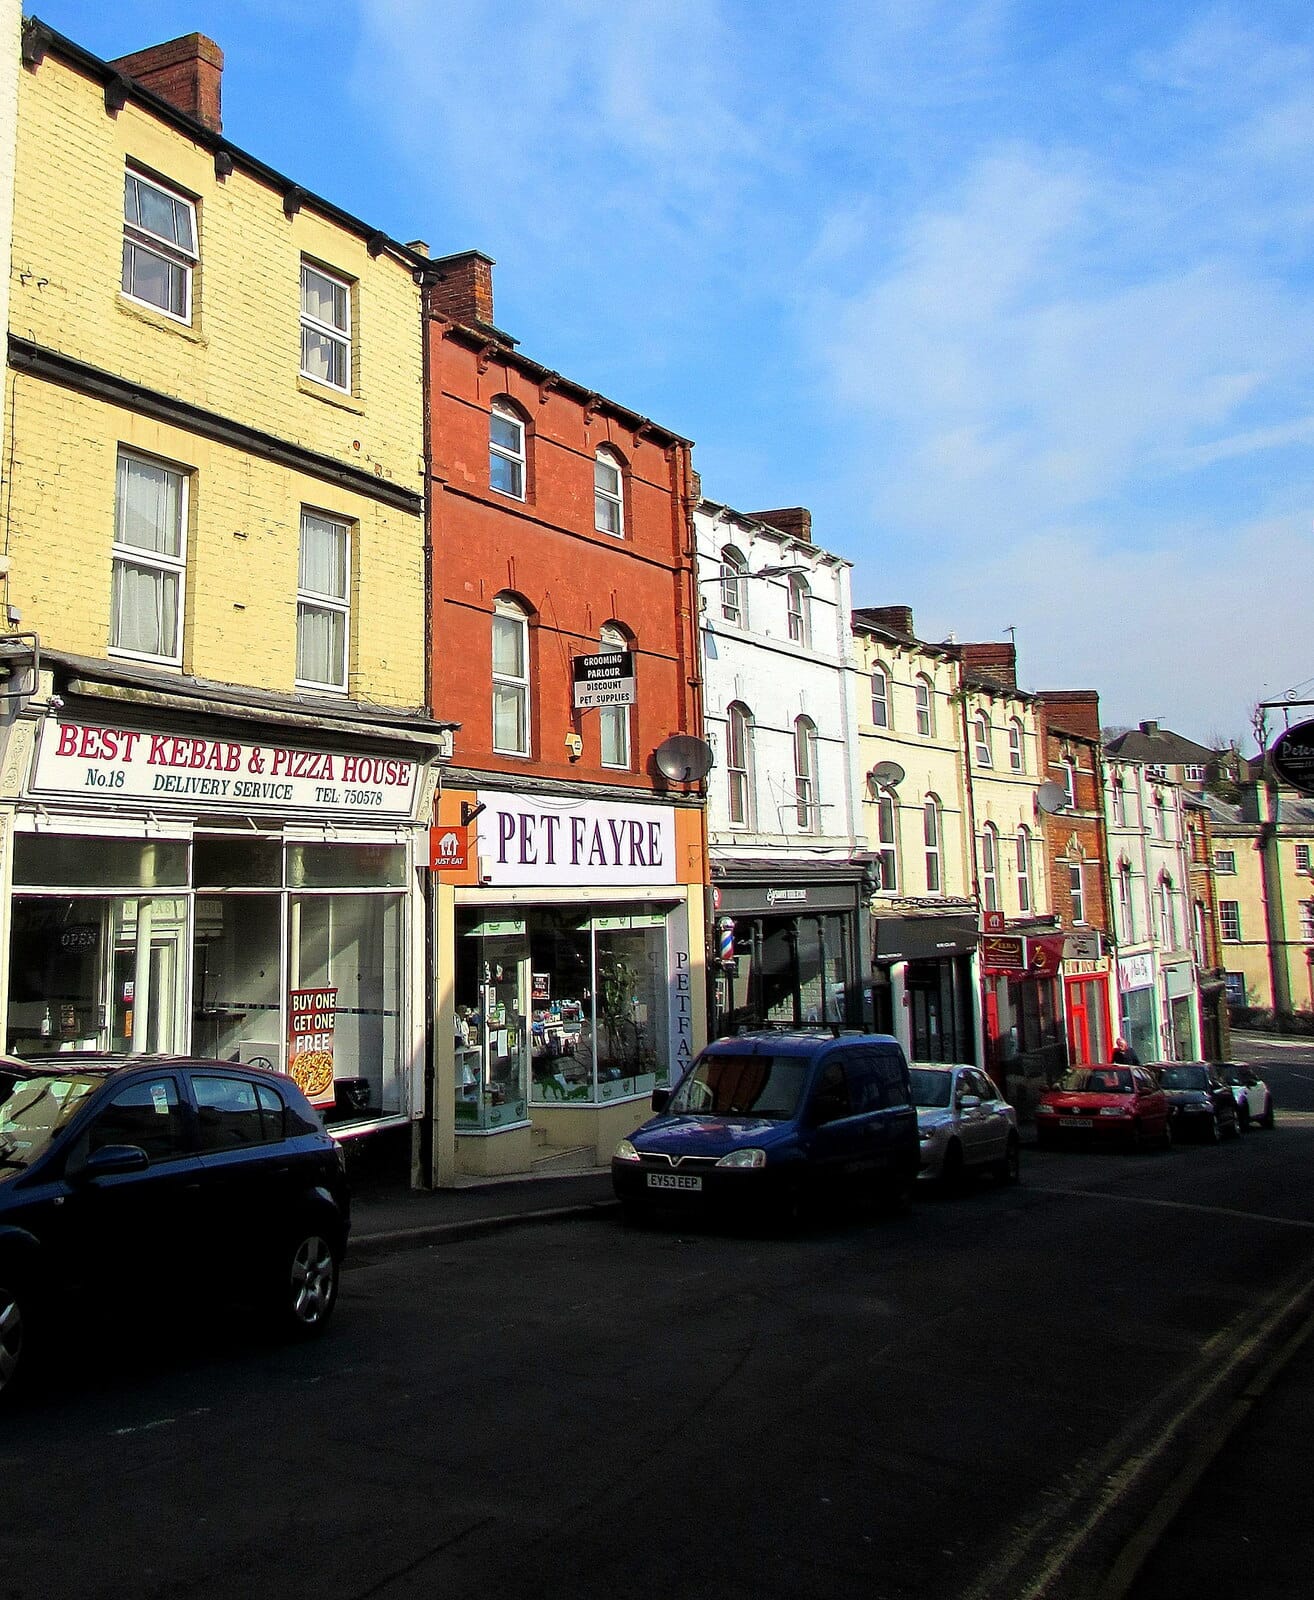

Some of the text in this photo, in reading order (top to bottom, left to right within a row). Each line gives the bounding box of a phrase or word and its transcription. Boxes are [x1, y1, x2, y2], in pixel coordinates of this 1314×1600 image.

[584, 654, 622, 666] GROOMING
[587, 667, 620, 679] PARLOUR
[586, 681, 621, 691] DISCOUNT
[580, 693, 630, 704] PET SUPPLIES
[56, 724, 411, 786] BEST KEBAB & PIZZA HOUSE
[85, 768, 125, 788] No.18
[153, 774, 230, 797] DELIVERY
[233, 780, 293, 800] SERVICE
[344, 789, 382, 806] 750578
[497, 811, 663, 867] PET FAYRE
[451, 857, 464, 865] EAT
[61, 932, 97, 946] OPEN
[293, 992, 335, 1011] BUY ONE
[294, 1013, 334, 1031] GET ONE
[296, 1033, 329, 1053] FREE
[650, 1174, 697, 1188] EY53 EEP
